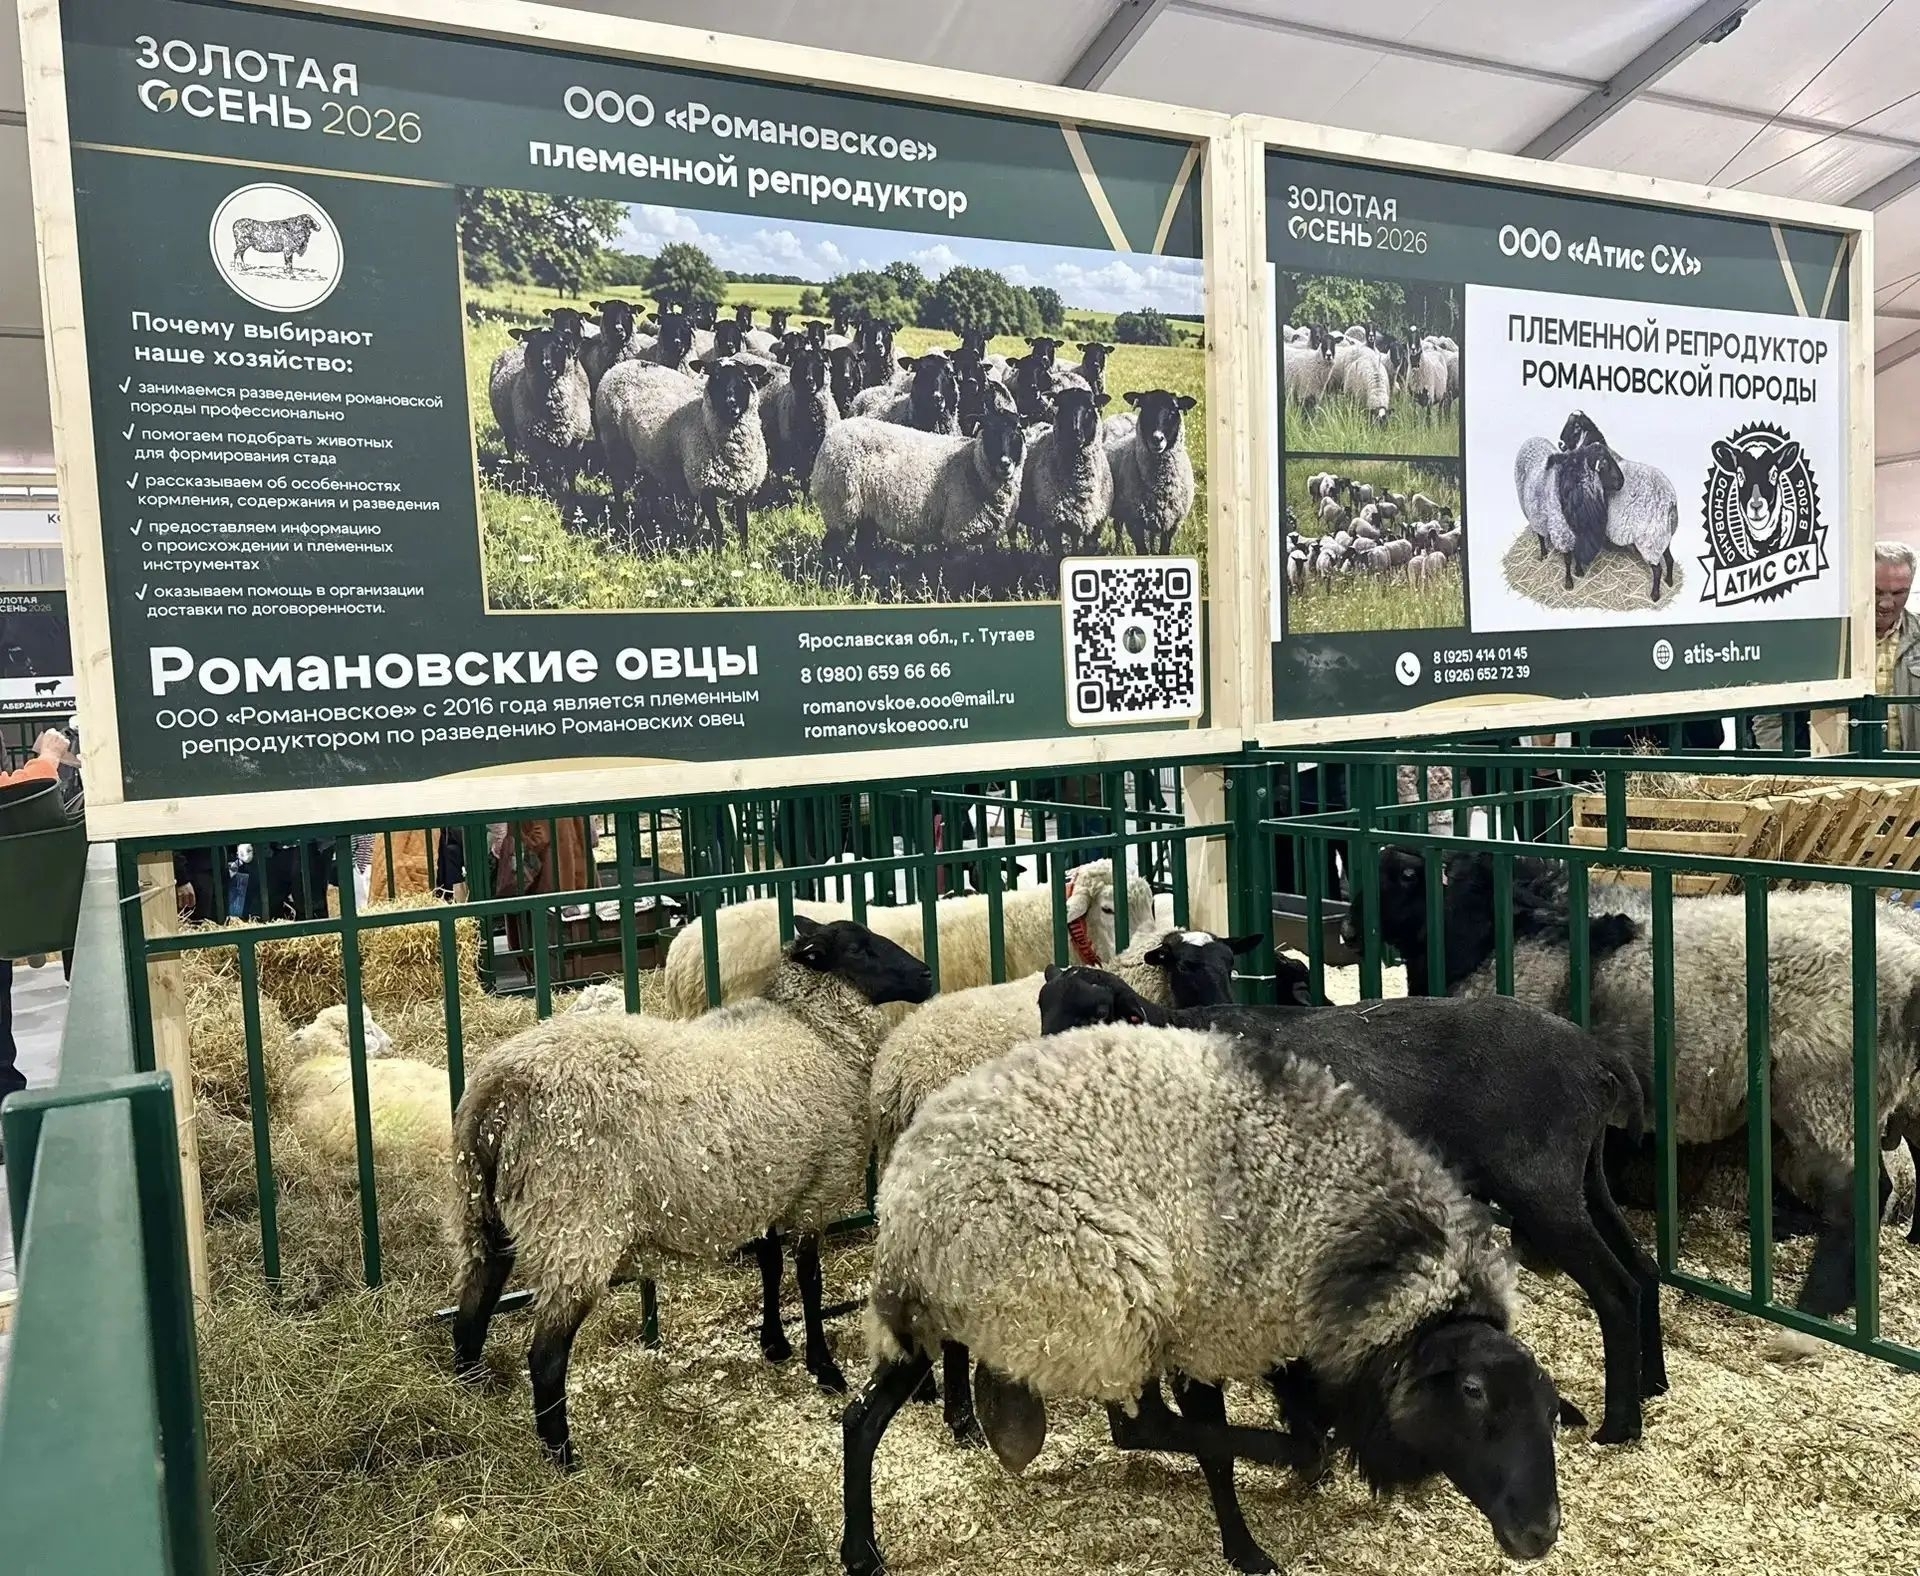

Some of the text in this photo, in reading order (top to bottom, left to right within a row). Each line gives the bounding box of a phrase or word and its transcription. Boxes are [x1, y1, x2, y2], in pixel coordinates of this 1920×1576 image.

[136, 36, 358, 96] ЗОЛОТАЯ
[137, 78, 421, 143] ОСЕНЬ 2026
[564, 86, 936, 163] ООО «Романовское»
[530, 141, 967, 219] племенной репродуктор
[1288, 186, 1396, 222] ЗОЛОТАЯ
[1288, 216, 1427, 253] ОСЕНЬ 2026
[1499, 225, 1701, 275] ООО «Атис СХ»
[132, 312, 373, 346] Почему выбирают
[1509, 314, 1827, 364] ПЛЕМЕННОЙ РЕПРОДУКТОР
[135, 347, 352, 372] наше хозяйство:
[1523, 360, 1816, 405] РОМАНОВСКОЙ ПОРОДЫ
[139, 384, 443, 408] занимаемся разведением романовской
[131, 403, 344, 420] породы профессионально
[142, 430, 393, 448] помогаем подобрать животных
[135, 447, 336, 465] для формирования стада
[146, 476, 401, 491] рассказываем об особенностях
[138, 496, 439, 511] кормления, содержания и разведения
[1795, 480, 1808, 530] В 2006
[150, 522, 381, 536] предоставляем информацию
[1713, 477, 1736, 562] ОСНОВАНО
[142, 542, 393, 554] о происхождении и племенных
[144, 561, 259, 573] инструментах
[1724, 550, 1810, 596] АТИС СХ
[154, 587, 424, 598] оказываем помощь в организации
[147, 604, 385, 618] доставки по договоренности.
[799, 628, 1035, 652] Ярославская обл., г. Тутаев
[1684, 640, 1760, 664] atis-sh.ru
[1434, 647, 1527, 664] 8 (925) 414 01 45
[150, 646, 758, 695] Романовские овцы
[801, 662, 950, 683] 8 (980) 659 66 66
[1434, 665, 1530, 683] 8 (926) 652 72 39
[2, 700, 75, 710] АБЕРДИН-АНГУС
[156, 690, 759, 728] ООО «Романовское» с 2016 года является племенным
[803, 689, 1014, 714] romanovskoe.ooo@mail.ru
[182, 713, 744, 760] репродуктором по разведению Романовских овец
[805, 718, 968, 738] romanovskoeooo.ru
